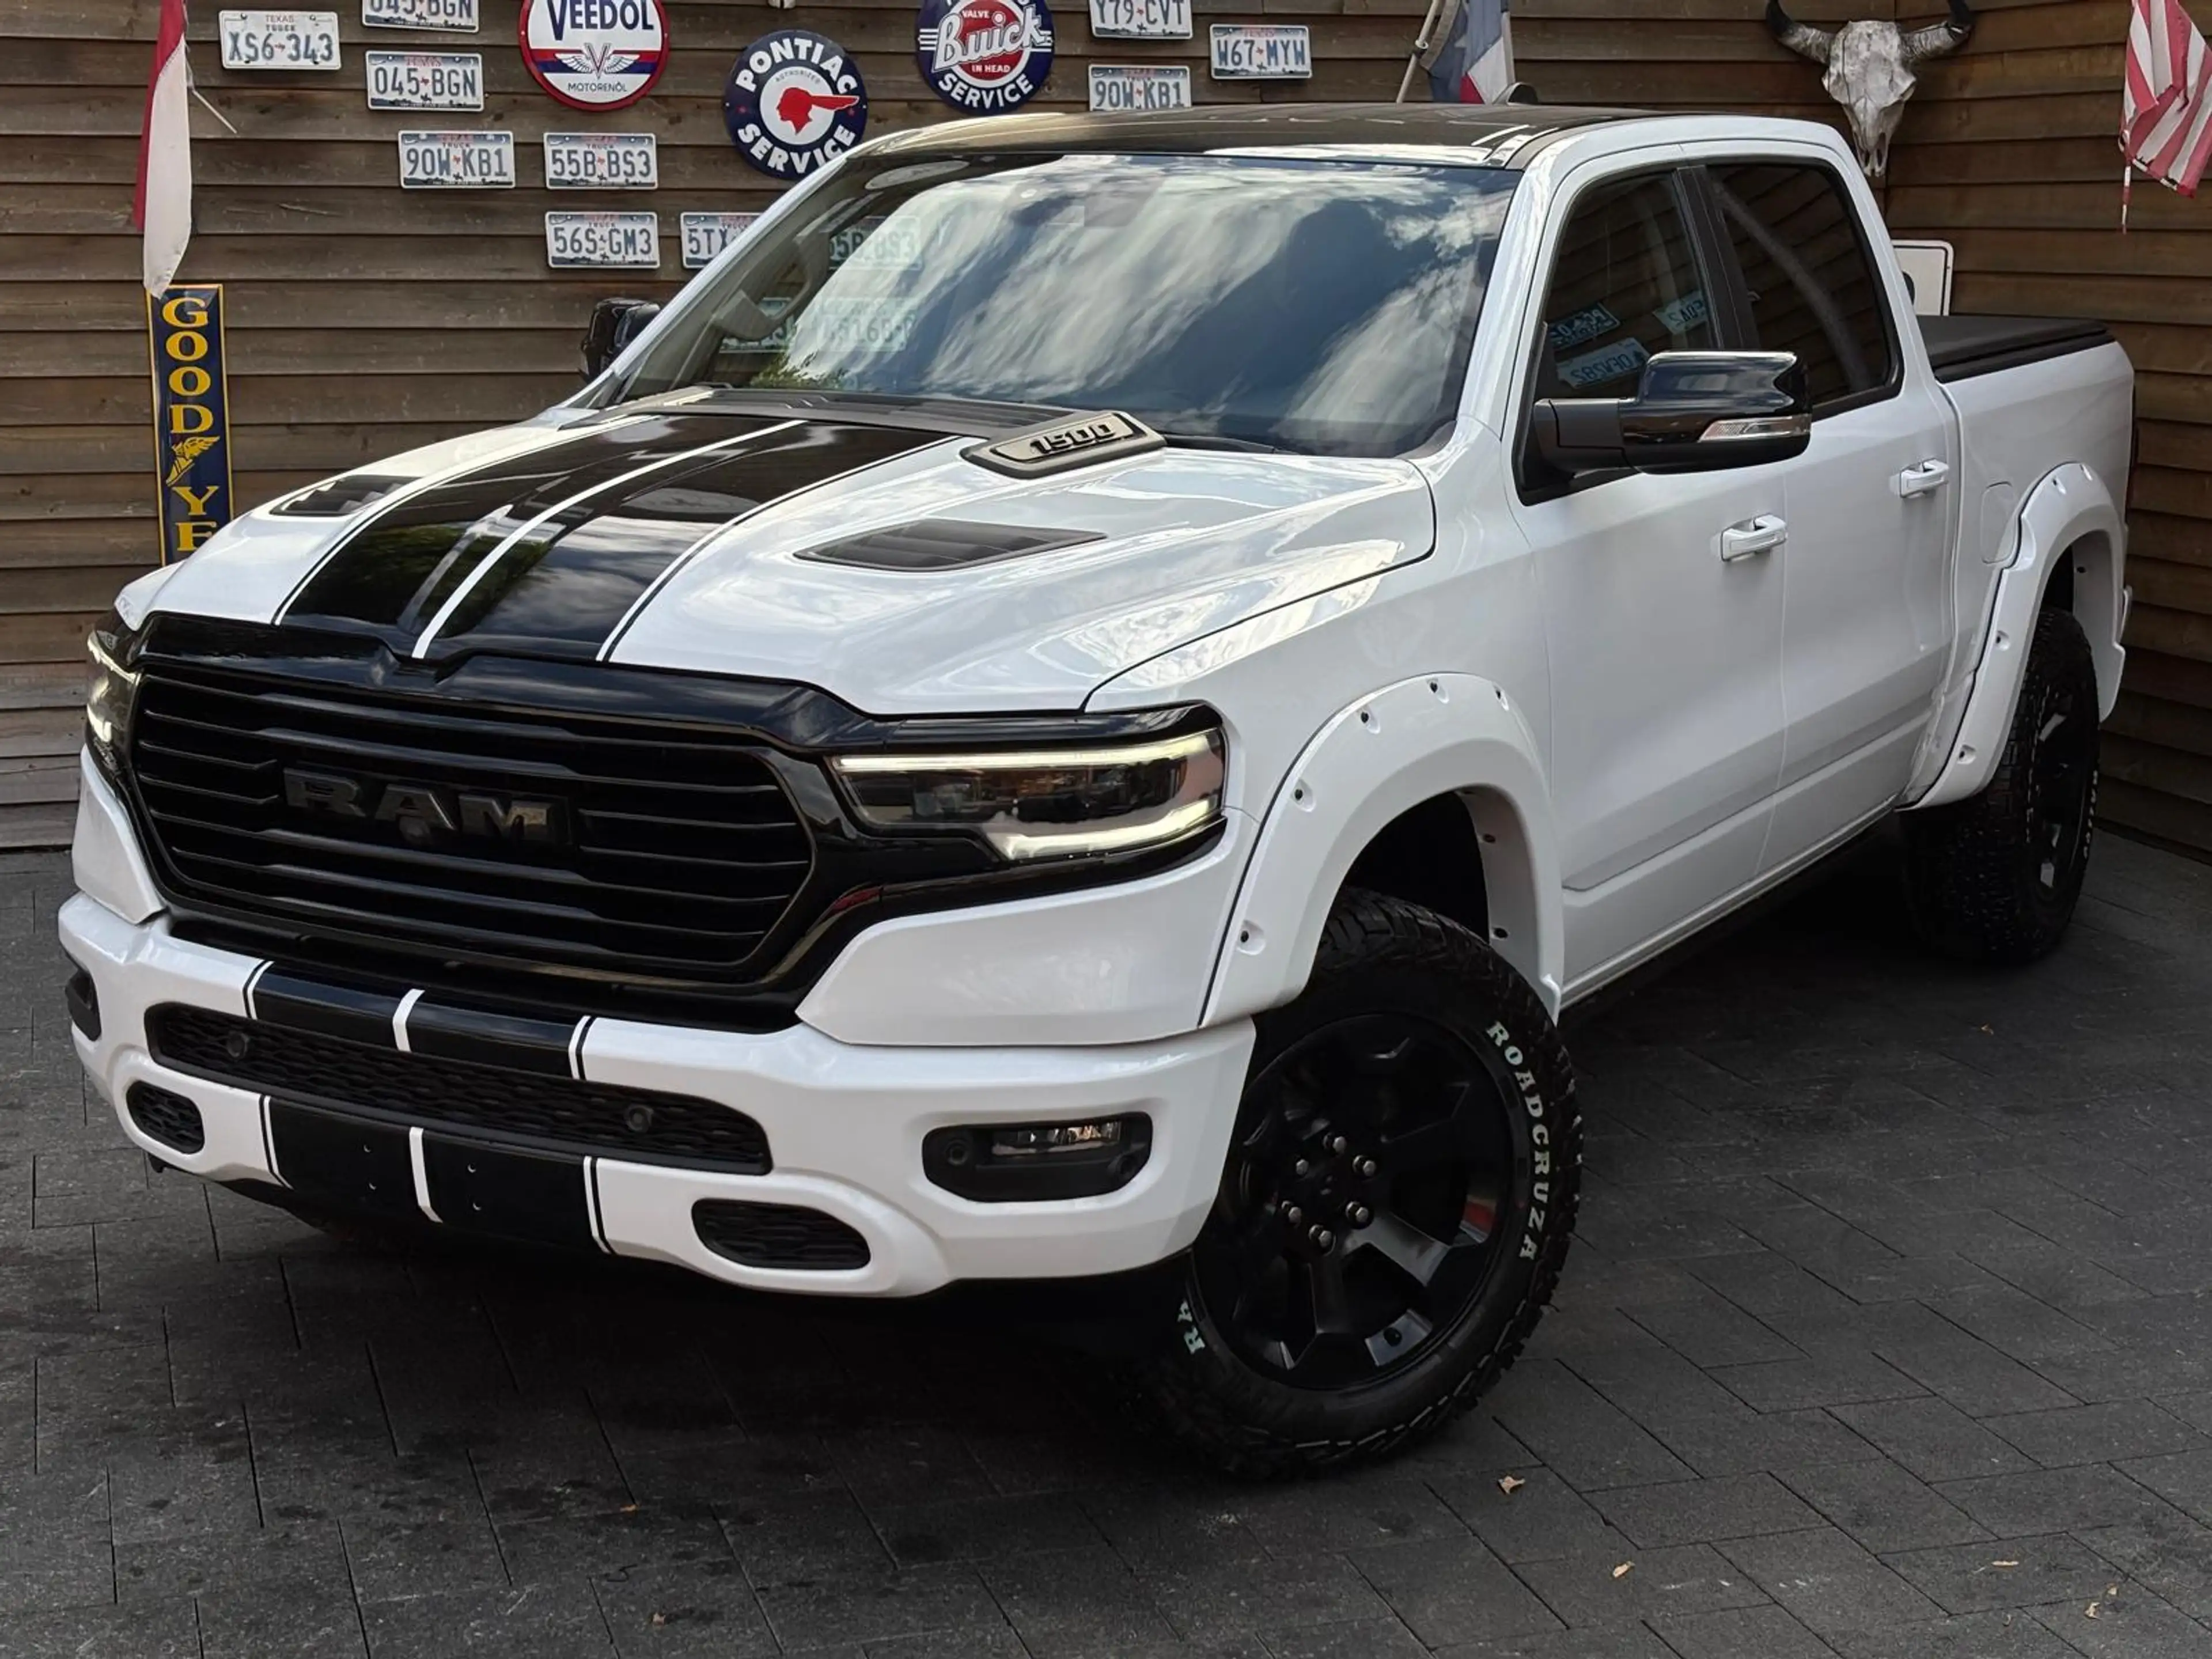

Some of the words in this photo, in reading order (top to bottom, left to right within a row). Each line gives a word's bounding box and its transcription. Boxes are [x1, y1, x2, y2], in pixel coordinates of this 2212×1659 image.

[547, 0, 654, 41] VEEDOL
[962, 10, 990, 19] VALVE
[931, 4, 1045, 73] Buick
[735, 37, 858, 94] PONTIAC
[972, 65, 982, 73] IN
[984, 65, 1010, 73] HEAD
[568, 82, 627, 92] MOTORENÖL
[938, 73, 1034, 109] SERVICE
[737, 123, 856, 173] SERVICE
[1029, 422, 1116, 454] 1500
[283, 768, 554, 840] RAM
[1485, 1020, 1550, 1261] ROADCRUZA
